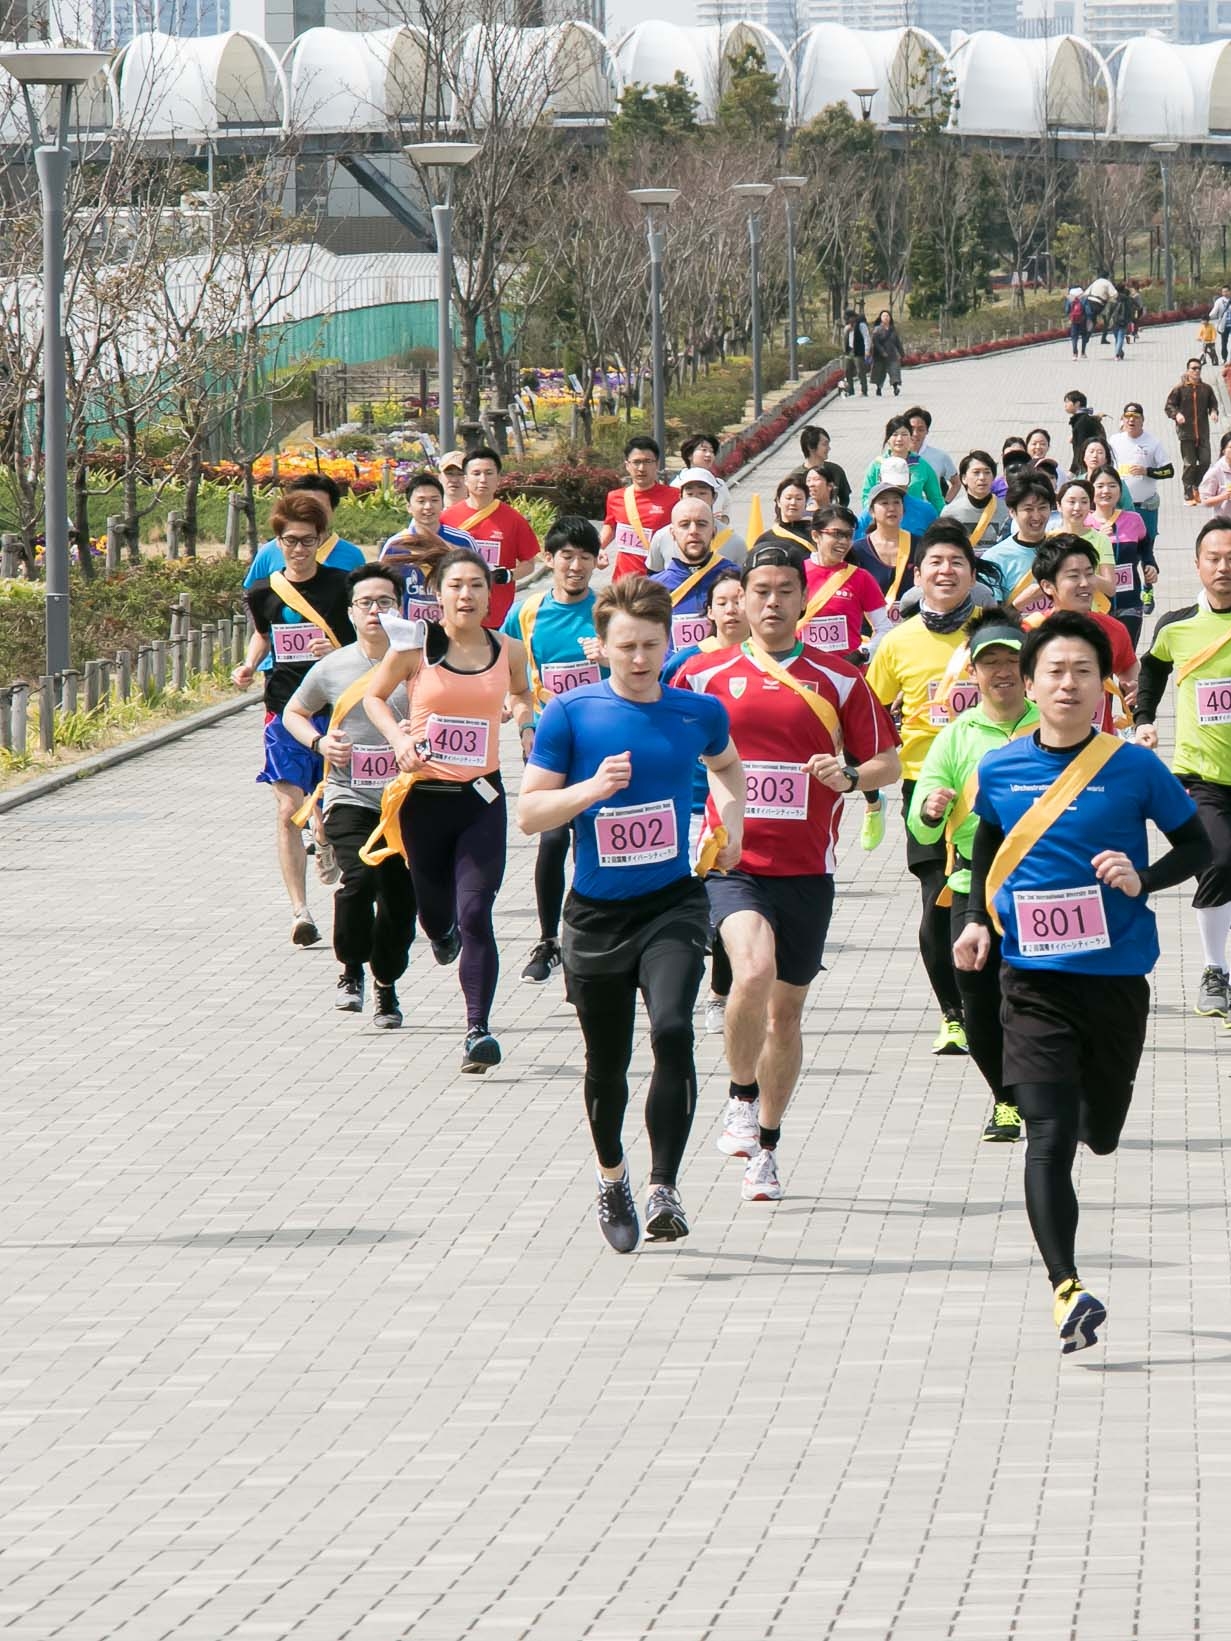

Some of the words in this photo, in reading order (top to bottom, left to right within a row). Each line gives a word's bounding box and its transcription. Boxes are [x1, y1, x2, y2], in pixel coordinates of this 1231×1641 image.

[809, 625, 840, 643] 503
[940, 691, 980, 713] 04
[434, 728, 478, 753] 403
[746, 775, 795, 804] 803
[611, 818, 665, 851] 802
[1032, 904, 1085, 937] 801
